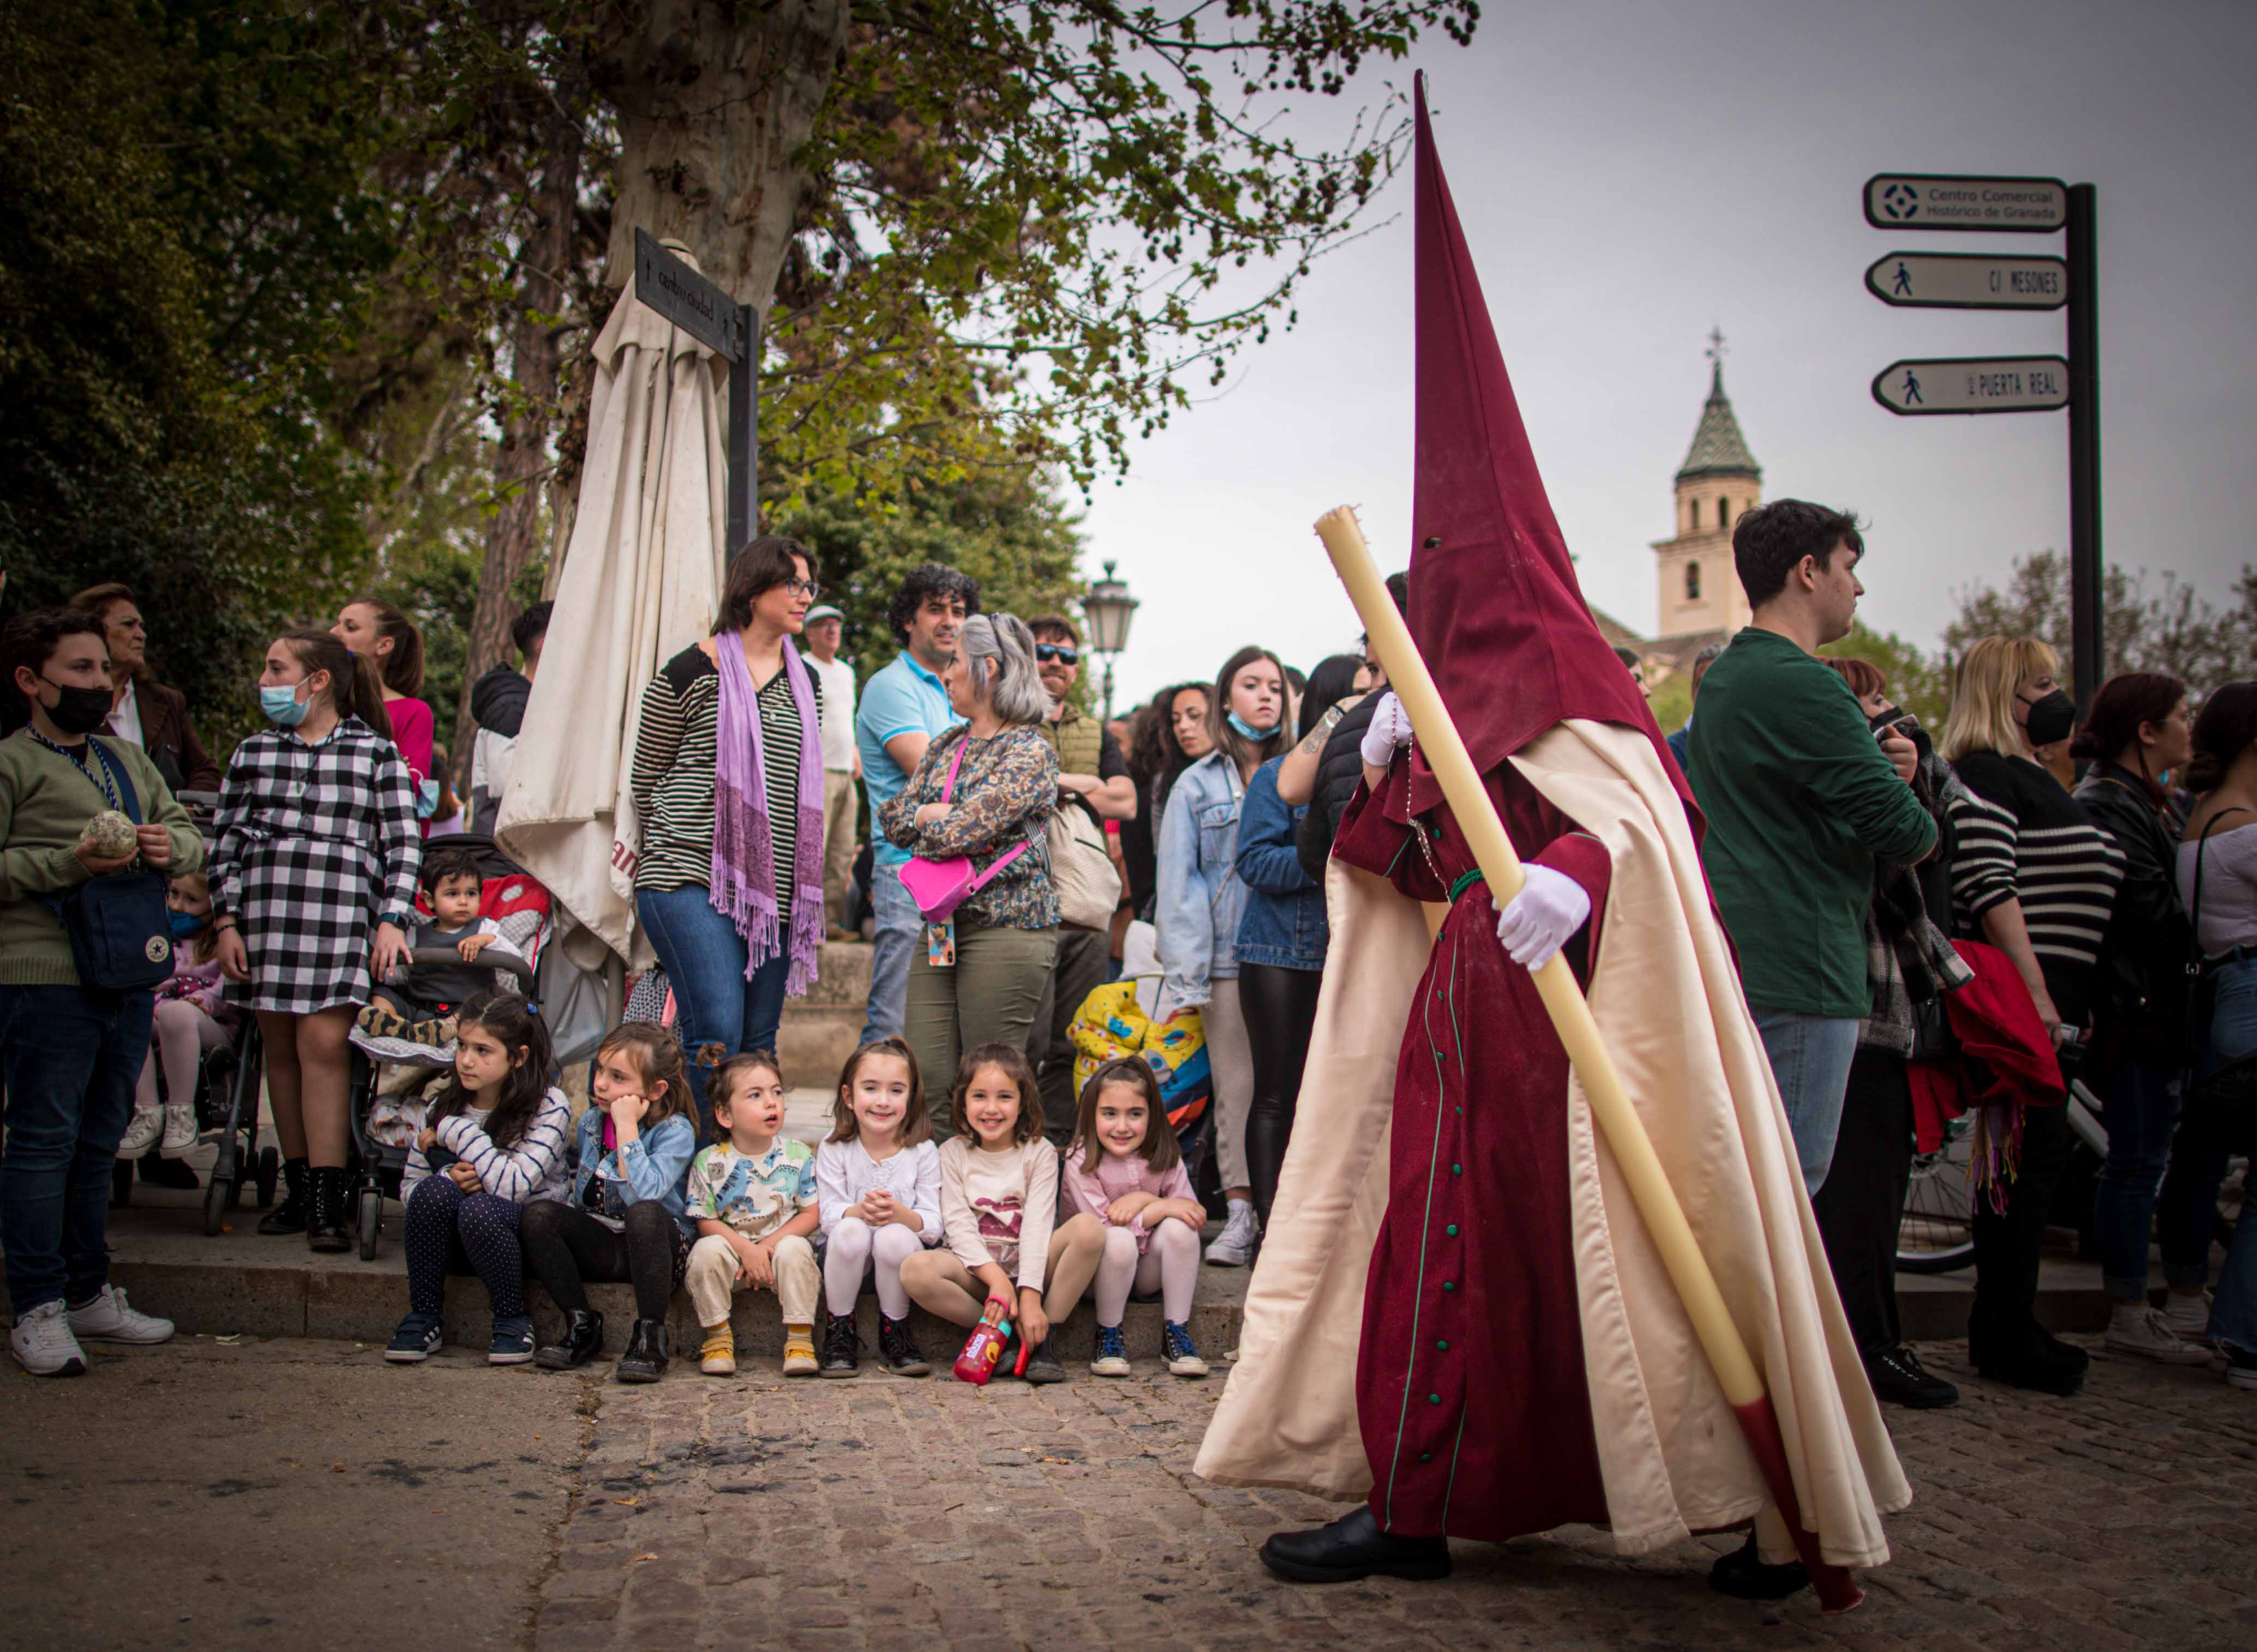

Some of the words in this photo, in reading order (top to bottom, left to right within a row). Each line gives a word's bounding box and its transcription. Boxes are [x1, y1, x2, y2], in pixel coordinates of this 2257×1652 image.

[1929, 188, 1978, 201] Centro
[1982, 189, 2053, 203] Comercial
[1927, 205, 1981, 218] Histórico
[1985, 206, 2000, 218] de
[2004, 207, 2056, 219] Granada
[2010, 270, 2059, 294] MESONES
[1979, 374, 2022, 396] PUERTA
[2030, 373, 2059, 394] REAL
